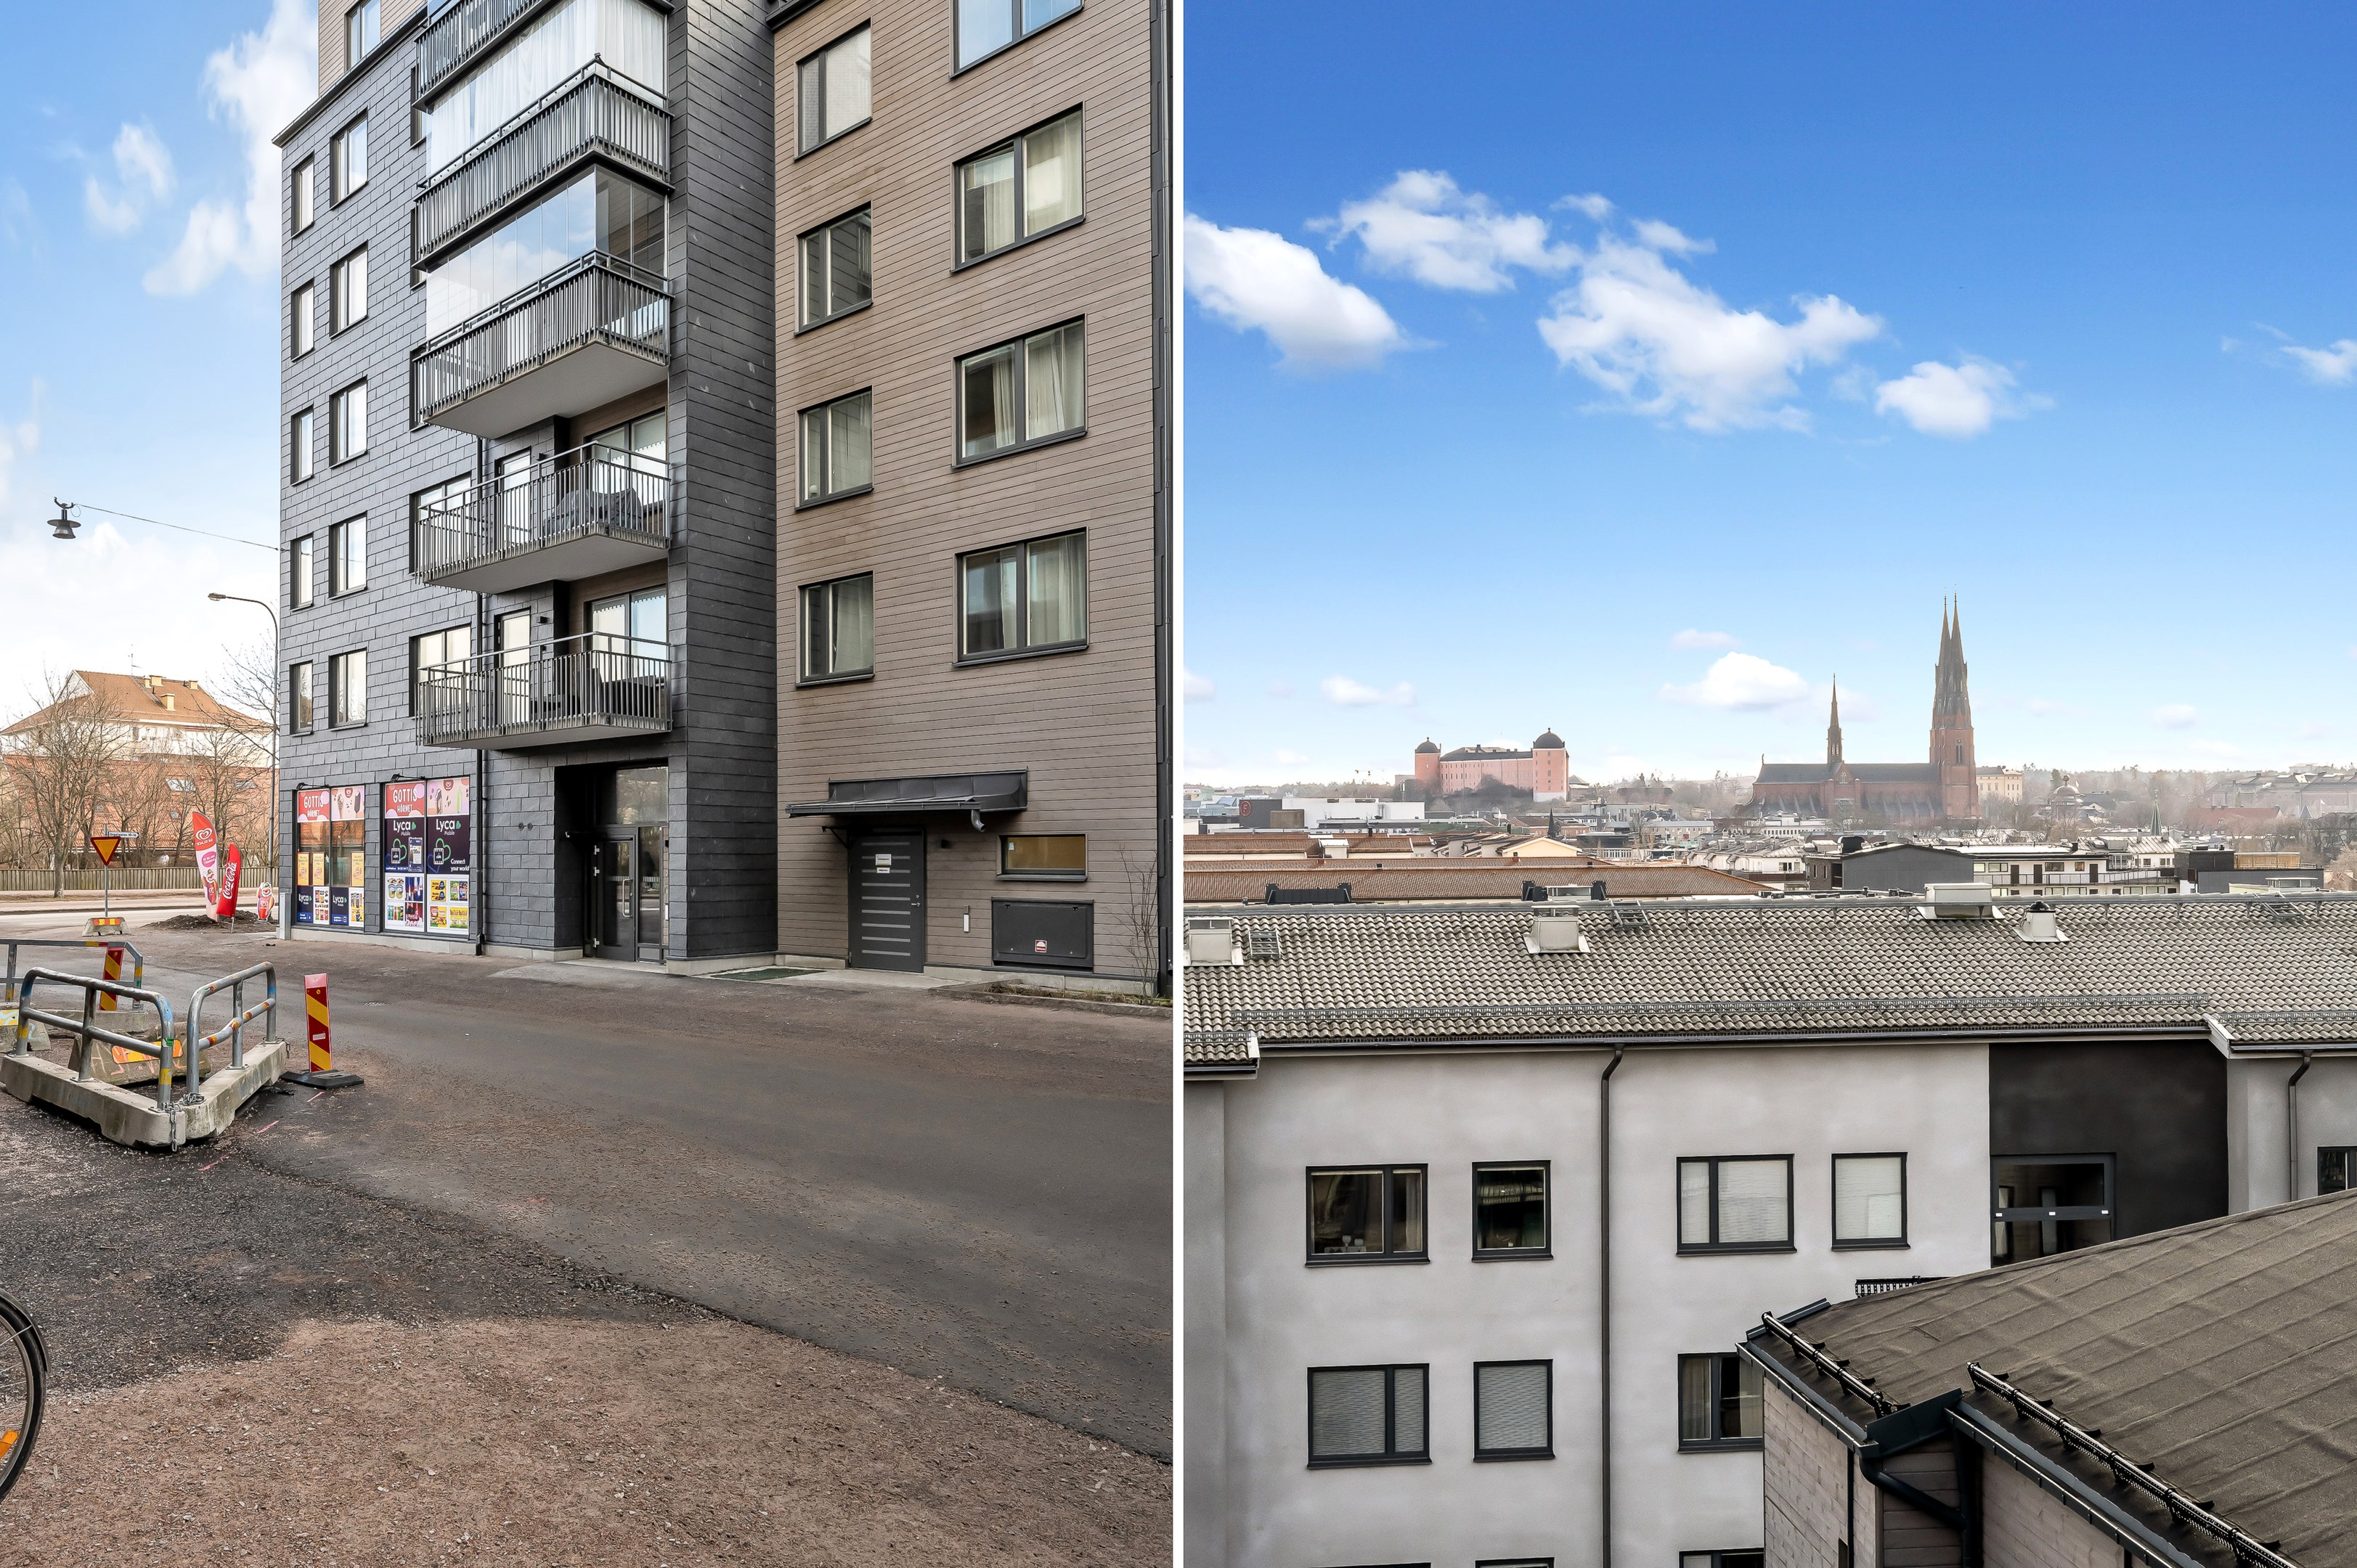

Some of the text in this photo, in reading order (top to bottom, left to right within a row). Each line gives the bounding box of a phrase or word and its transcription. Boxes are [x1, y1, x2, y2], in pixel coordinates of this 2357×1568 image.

[304, 795, 324, 809] GOTTIS
[393, 788, 417, 803] GOTTIS
[393, 820, 411, 833] Lyca
[436, 819, 455, 833] Lyca
[298, 894, 309, 902] Lyca
[333, 895, 344, 905] Lyca
